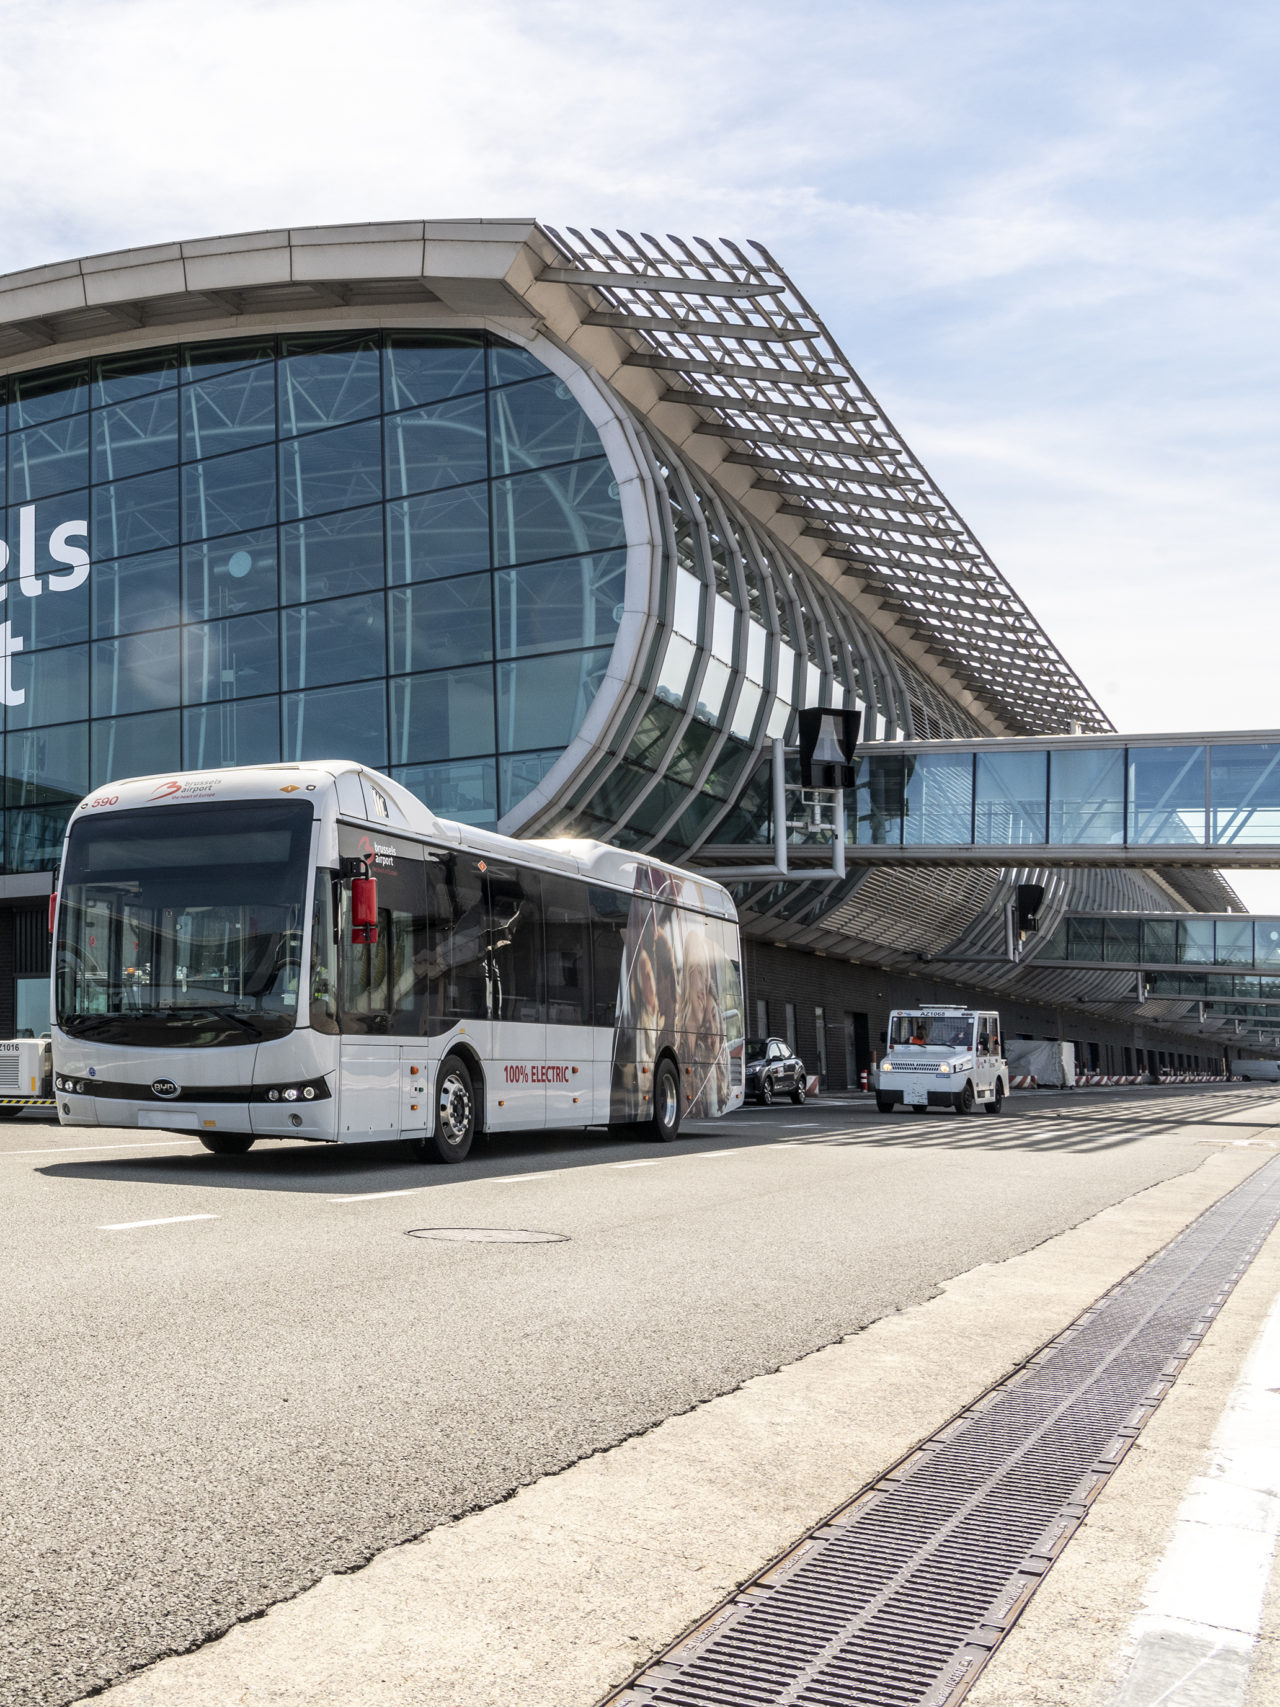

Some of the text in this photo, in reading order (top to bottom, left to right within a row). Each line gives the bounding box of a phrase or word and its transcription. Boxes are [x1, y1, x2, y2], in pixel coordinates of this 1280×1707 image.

[181, 785, 213, 793] airport
[184, 779, 222, 787] brussels
[91, 795, 119, 808] 590
[374, 842, 397, 856] brussels
[375, 854, 394, 867] airport
[504, 1064, 569, 1083] 100% ELECTRIC
[154, 1083, 174, 1091] BYD
